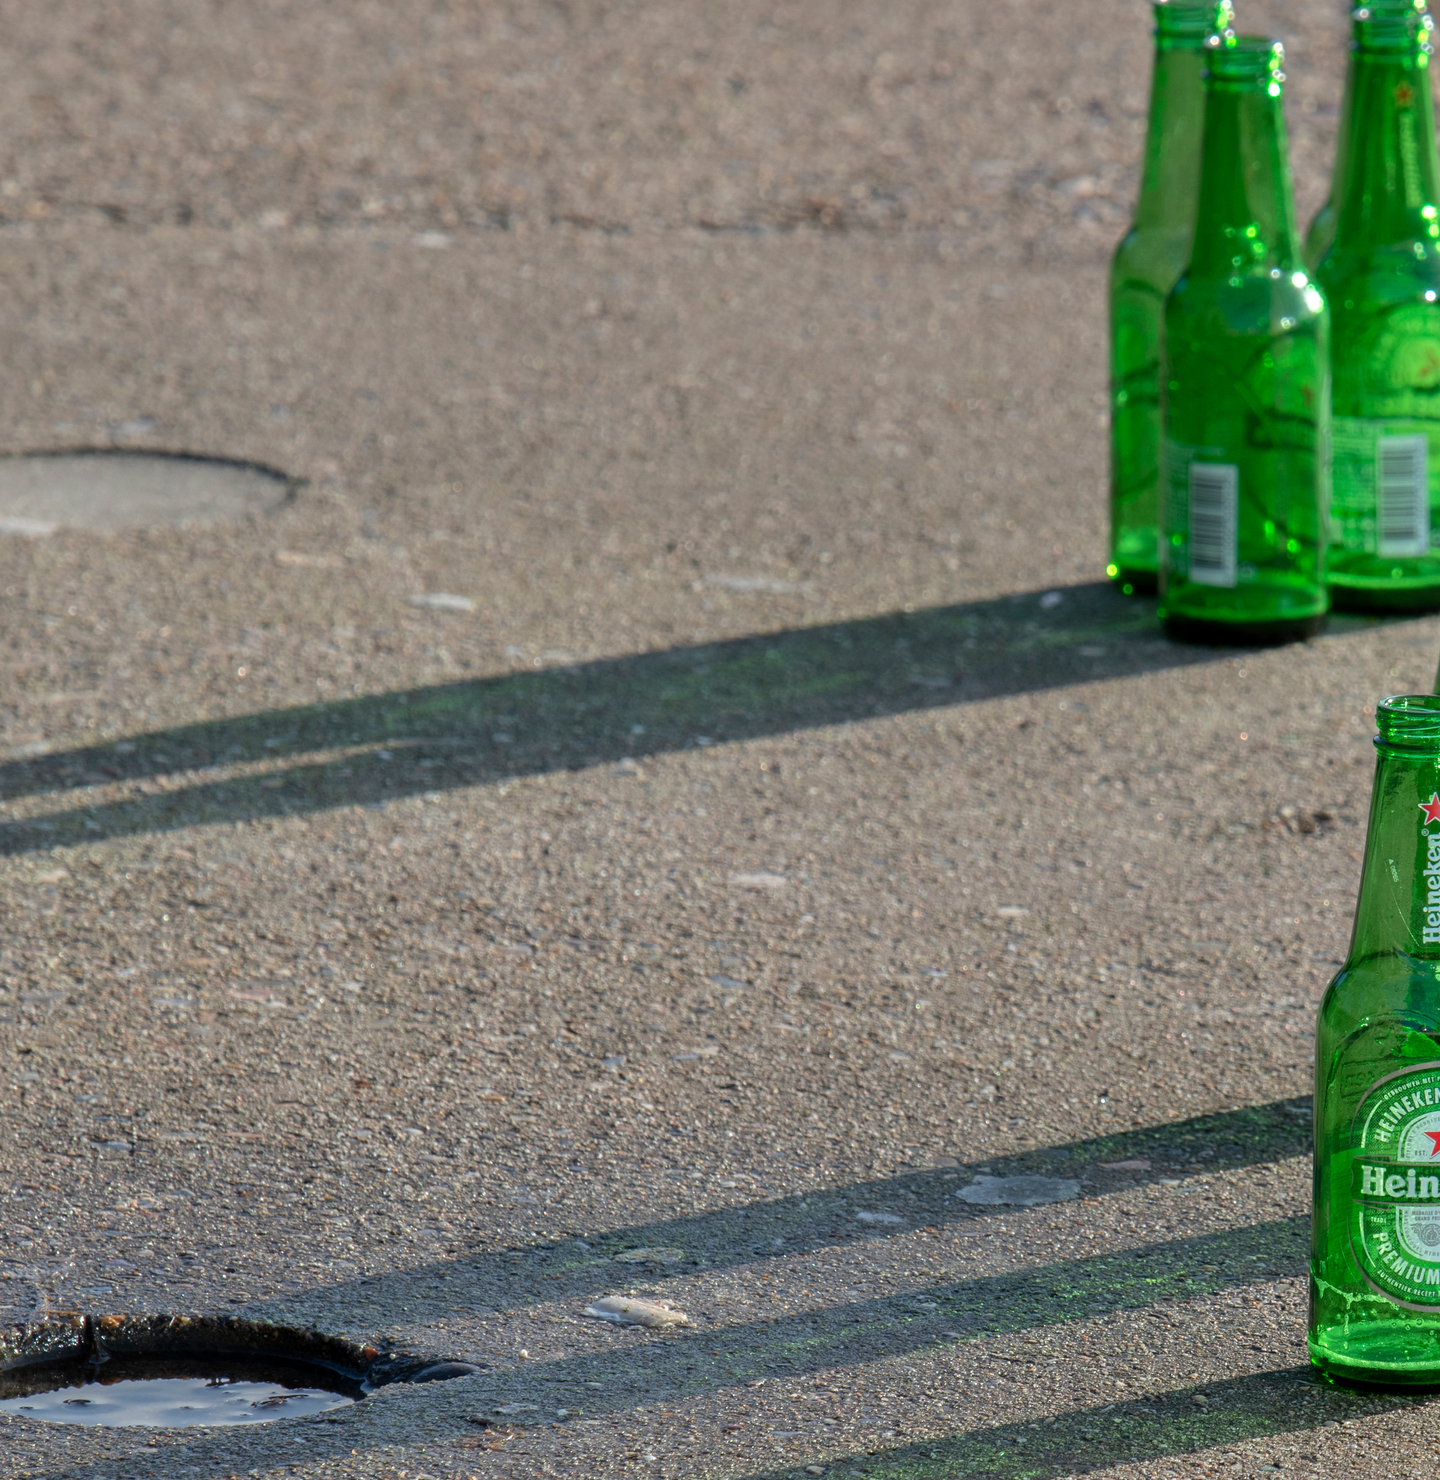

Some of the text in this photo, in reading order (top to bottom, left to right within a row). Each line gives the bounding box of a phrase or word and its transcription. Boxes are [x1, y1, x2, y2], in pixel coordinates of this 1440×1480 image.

[1422, 1076, 1435, 1084] MET
[1372, 1231, 1440, 1285] PREMIUM
[1376, 1269, 1412, 1294] AUTHENTIEK
[1413, 1288, 1436, 1297] RECEPT
